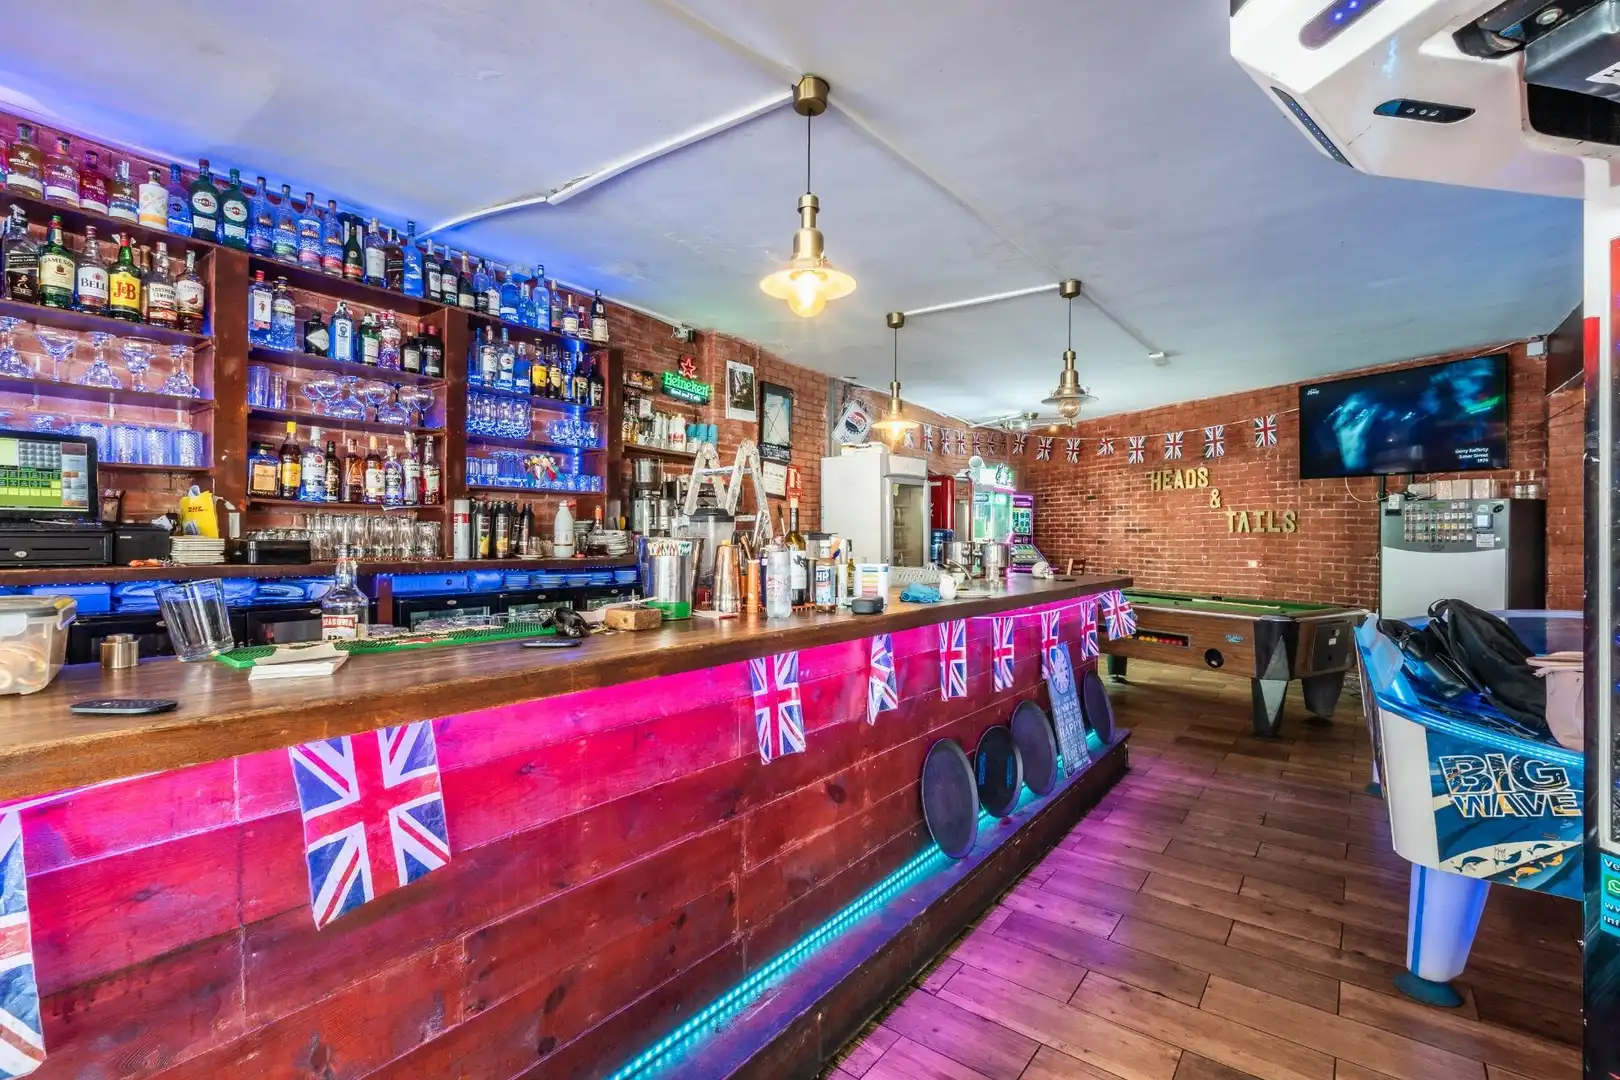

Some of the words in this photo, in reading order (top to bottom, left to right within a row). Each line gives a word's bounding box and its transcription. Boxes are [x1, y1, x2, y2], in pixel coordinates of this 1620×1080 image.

[43, 256, 74, 268] JAMESON
[664, 371, 710, 398] Heineken
[1149, 467, 1209, 491] HEADS
[1209, 488, 1221, 509] &
[1225, 506, 1296, 533] TAILS
[816, 571, 829, 582] HP
[1059, 720, 1083, 737] HAPPY
[1439, 753, 1571, 795] BIG
[1452, 792, 1583, 818] WAVE
